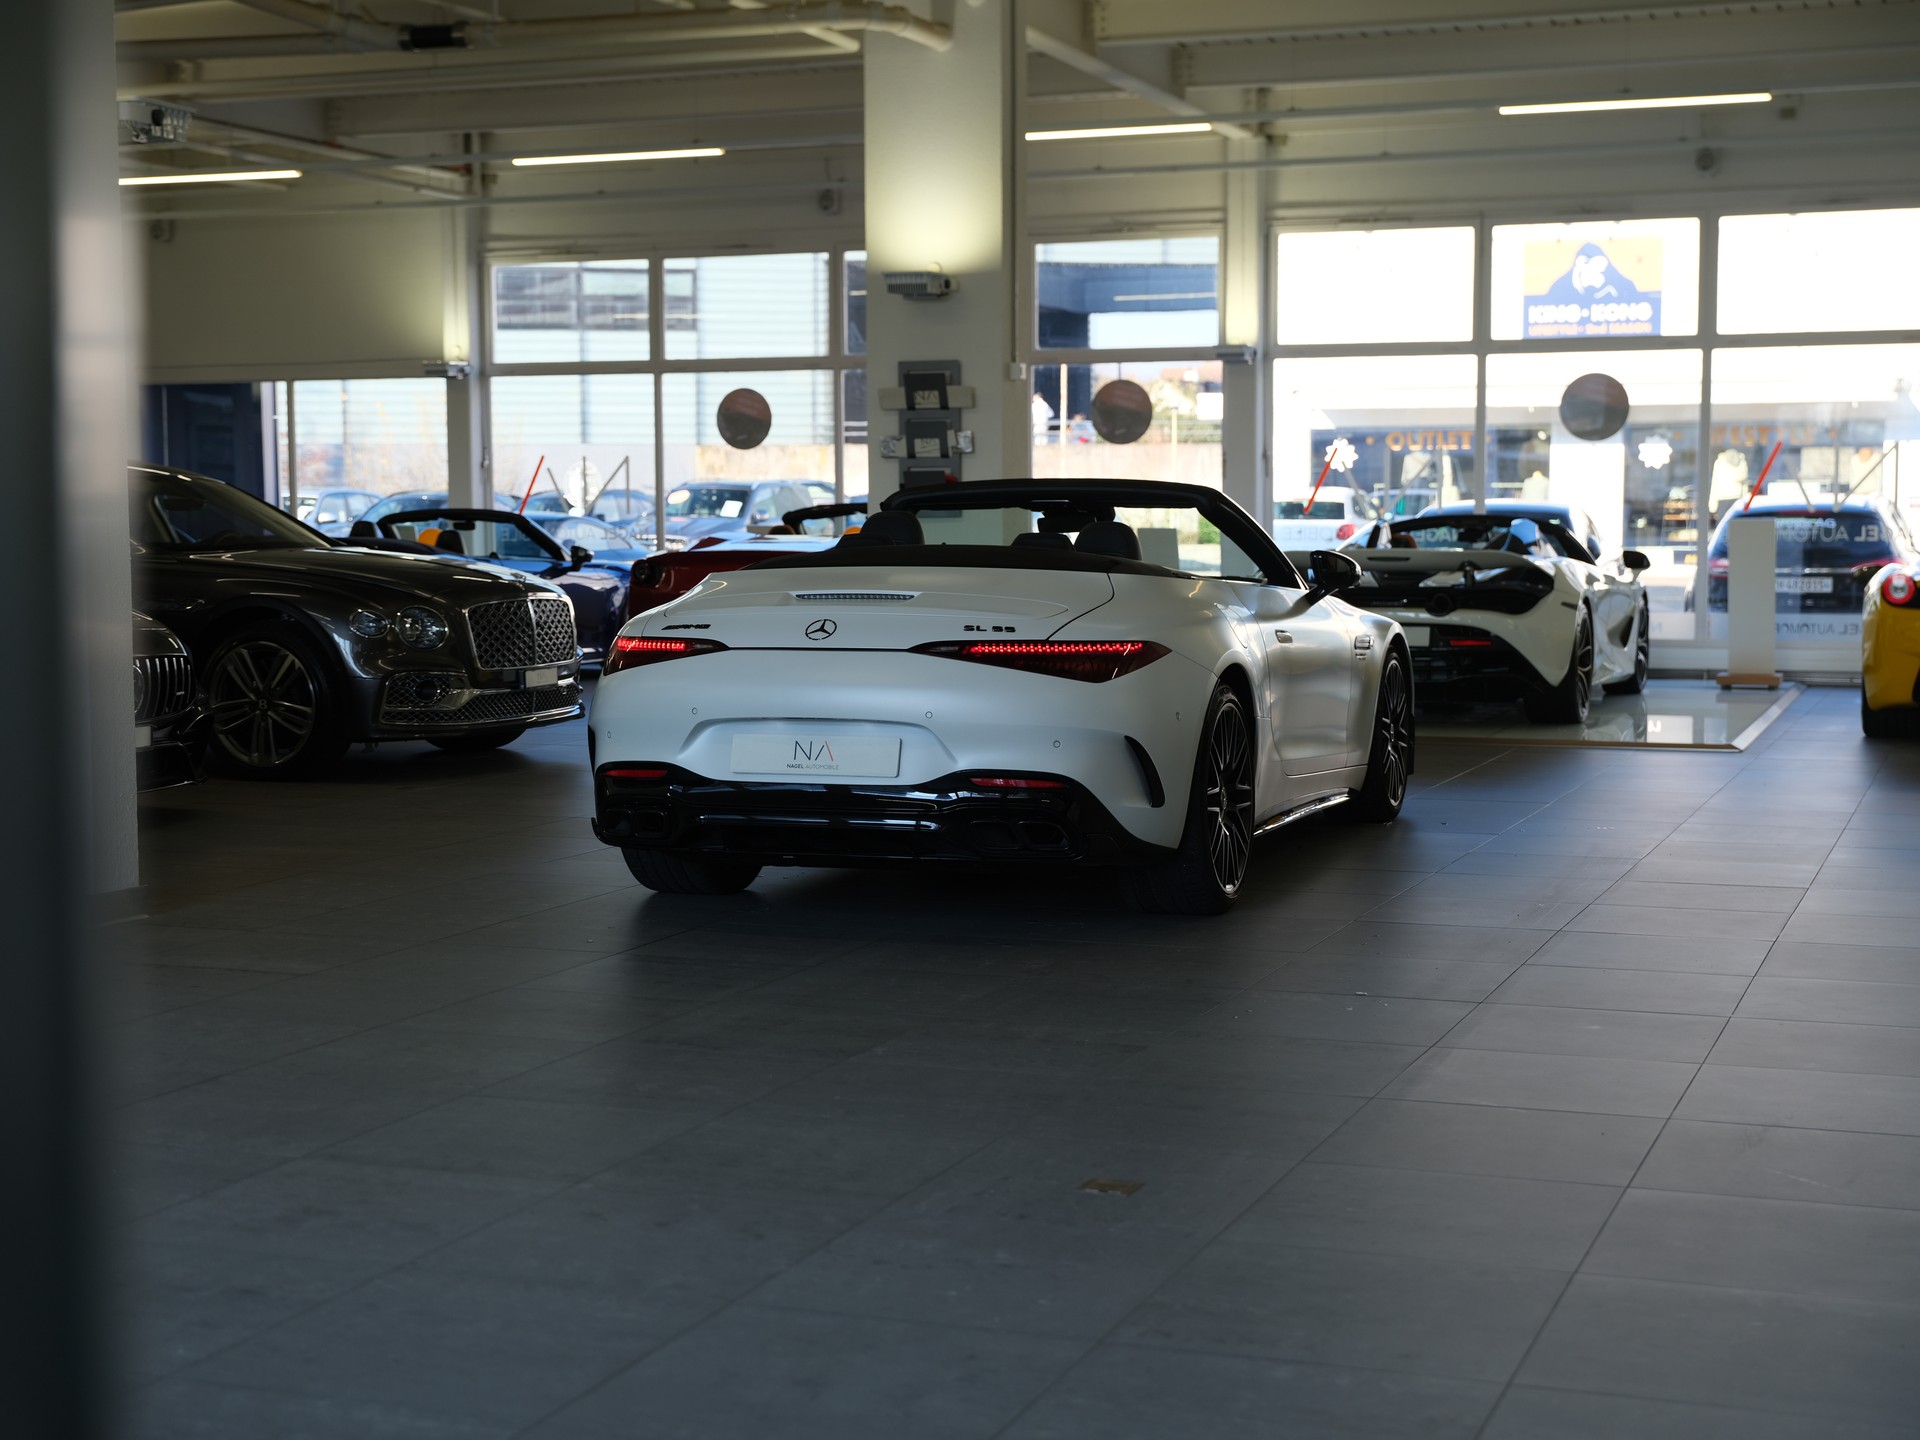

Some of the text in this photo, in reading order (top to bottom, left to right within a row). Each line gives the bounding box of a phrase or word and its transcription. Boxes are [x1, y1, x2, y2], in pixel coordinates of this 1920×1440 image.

[1528, 301, 1653, 323] KING KONG
[1385, 430, 1474, 451] OUTLET
[794, 740, 833, 761] NA
